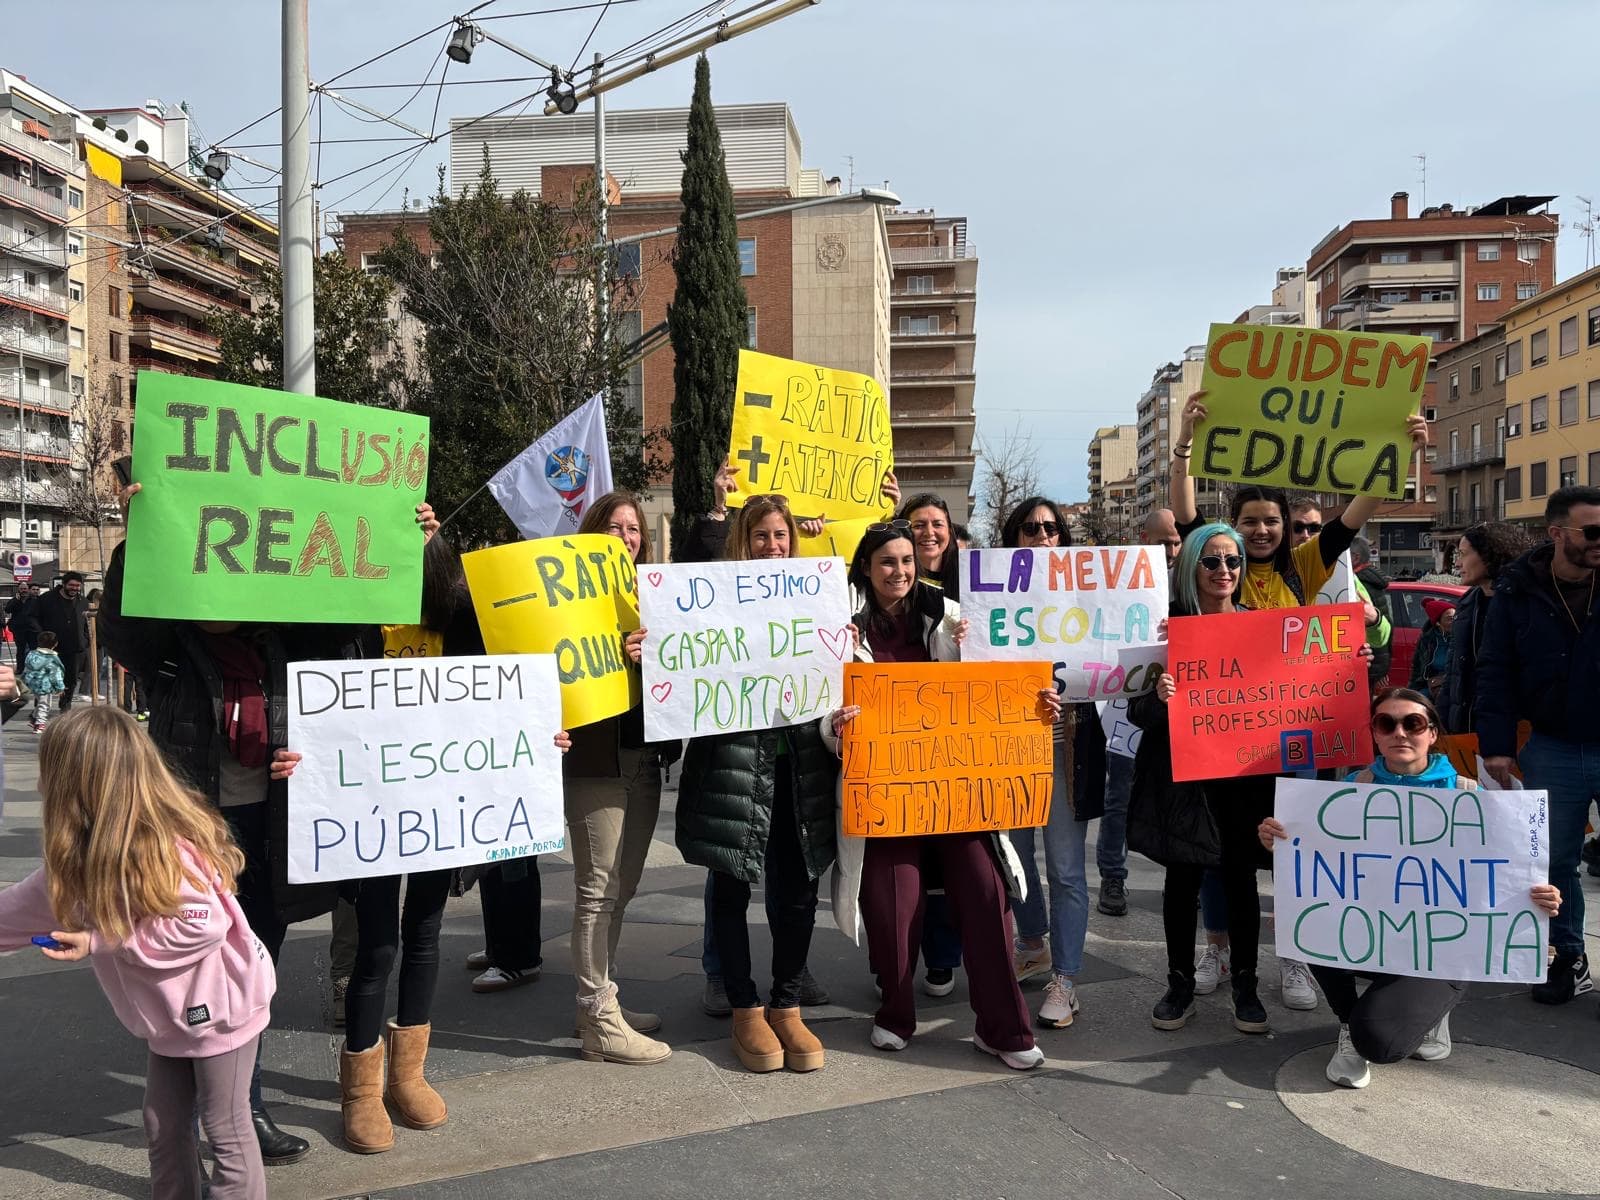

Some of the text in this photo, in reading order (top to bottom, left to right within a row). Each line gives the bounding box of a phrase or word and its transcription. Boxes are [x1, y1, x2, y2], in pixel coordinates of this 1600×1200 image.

[1202, 426, 1398, 492] EDUCA
[192, 504, 390, 580] REAL
[969, 548, 1156, 594] LA MEVA
[657, 618, 814, 672] GASPAR DE
[989, 602, 1150, 647] ESCOLA
[1281, 614, 1353, 655] PAE
[297, 663, 524, 716] DEFENSEM
[1176, 658, 1244, 682] PER LA
[693, 667, 831, 732] PORTOLÀ
[851, 674, 1044, 735] MESTRES
[338, 729, 534, 787] L'ESCOLA
[1288, 741, 1304, 760] B
[847, 772, 1053, 835] ESTEM EDUCANT
[1317, 788, 1486, 847] CADA
[1293, 902, 1541, 978] COMPTA
